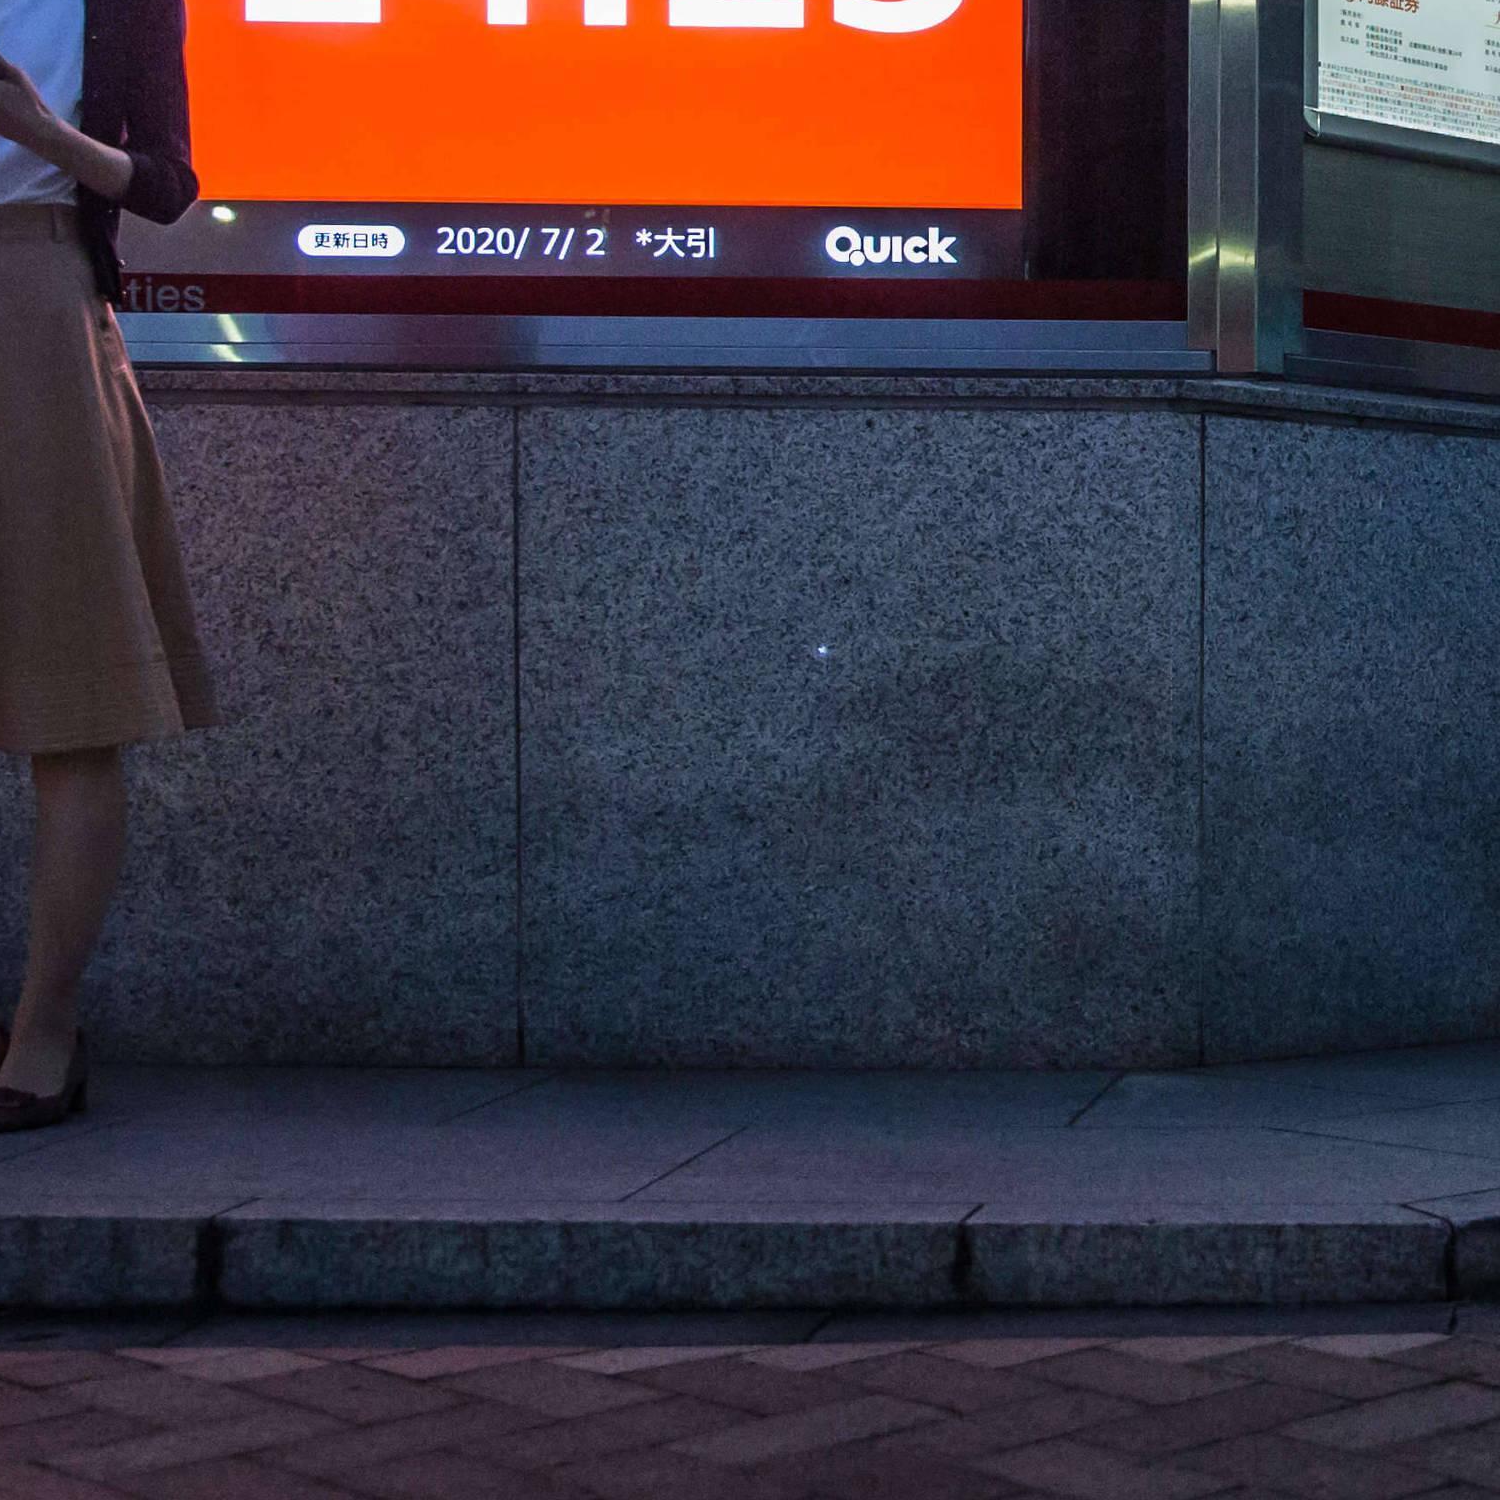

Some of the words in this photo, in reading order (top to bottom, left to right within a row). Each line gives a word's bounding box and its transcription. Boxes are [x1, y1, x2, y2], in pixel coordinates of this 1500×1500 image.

[313, 231, 390, 250] 更新日時
[436, 226, 531, 261] 2020/
[116, 276, 206, 312] ties
